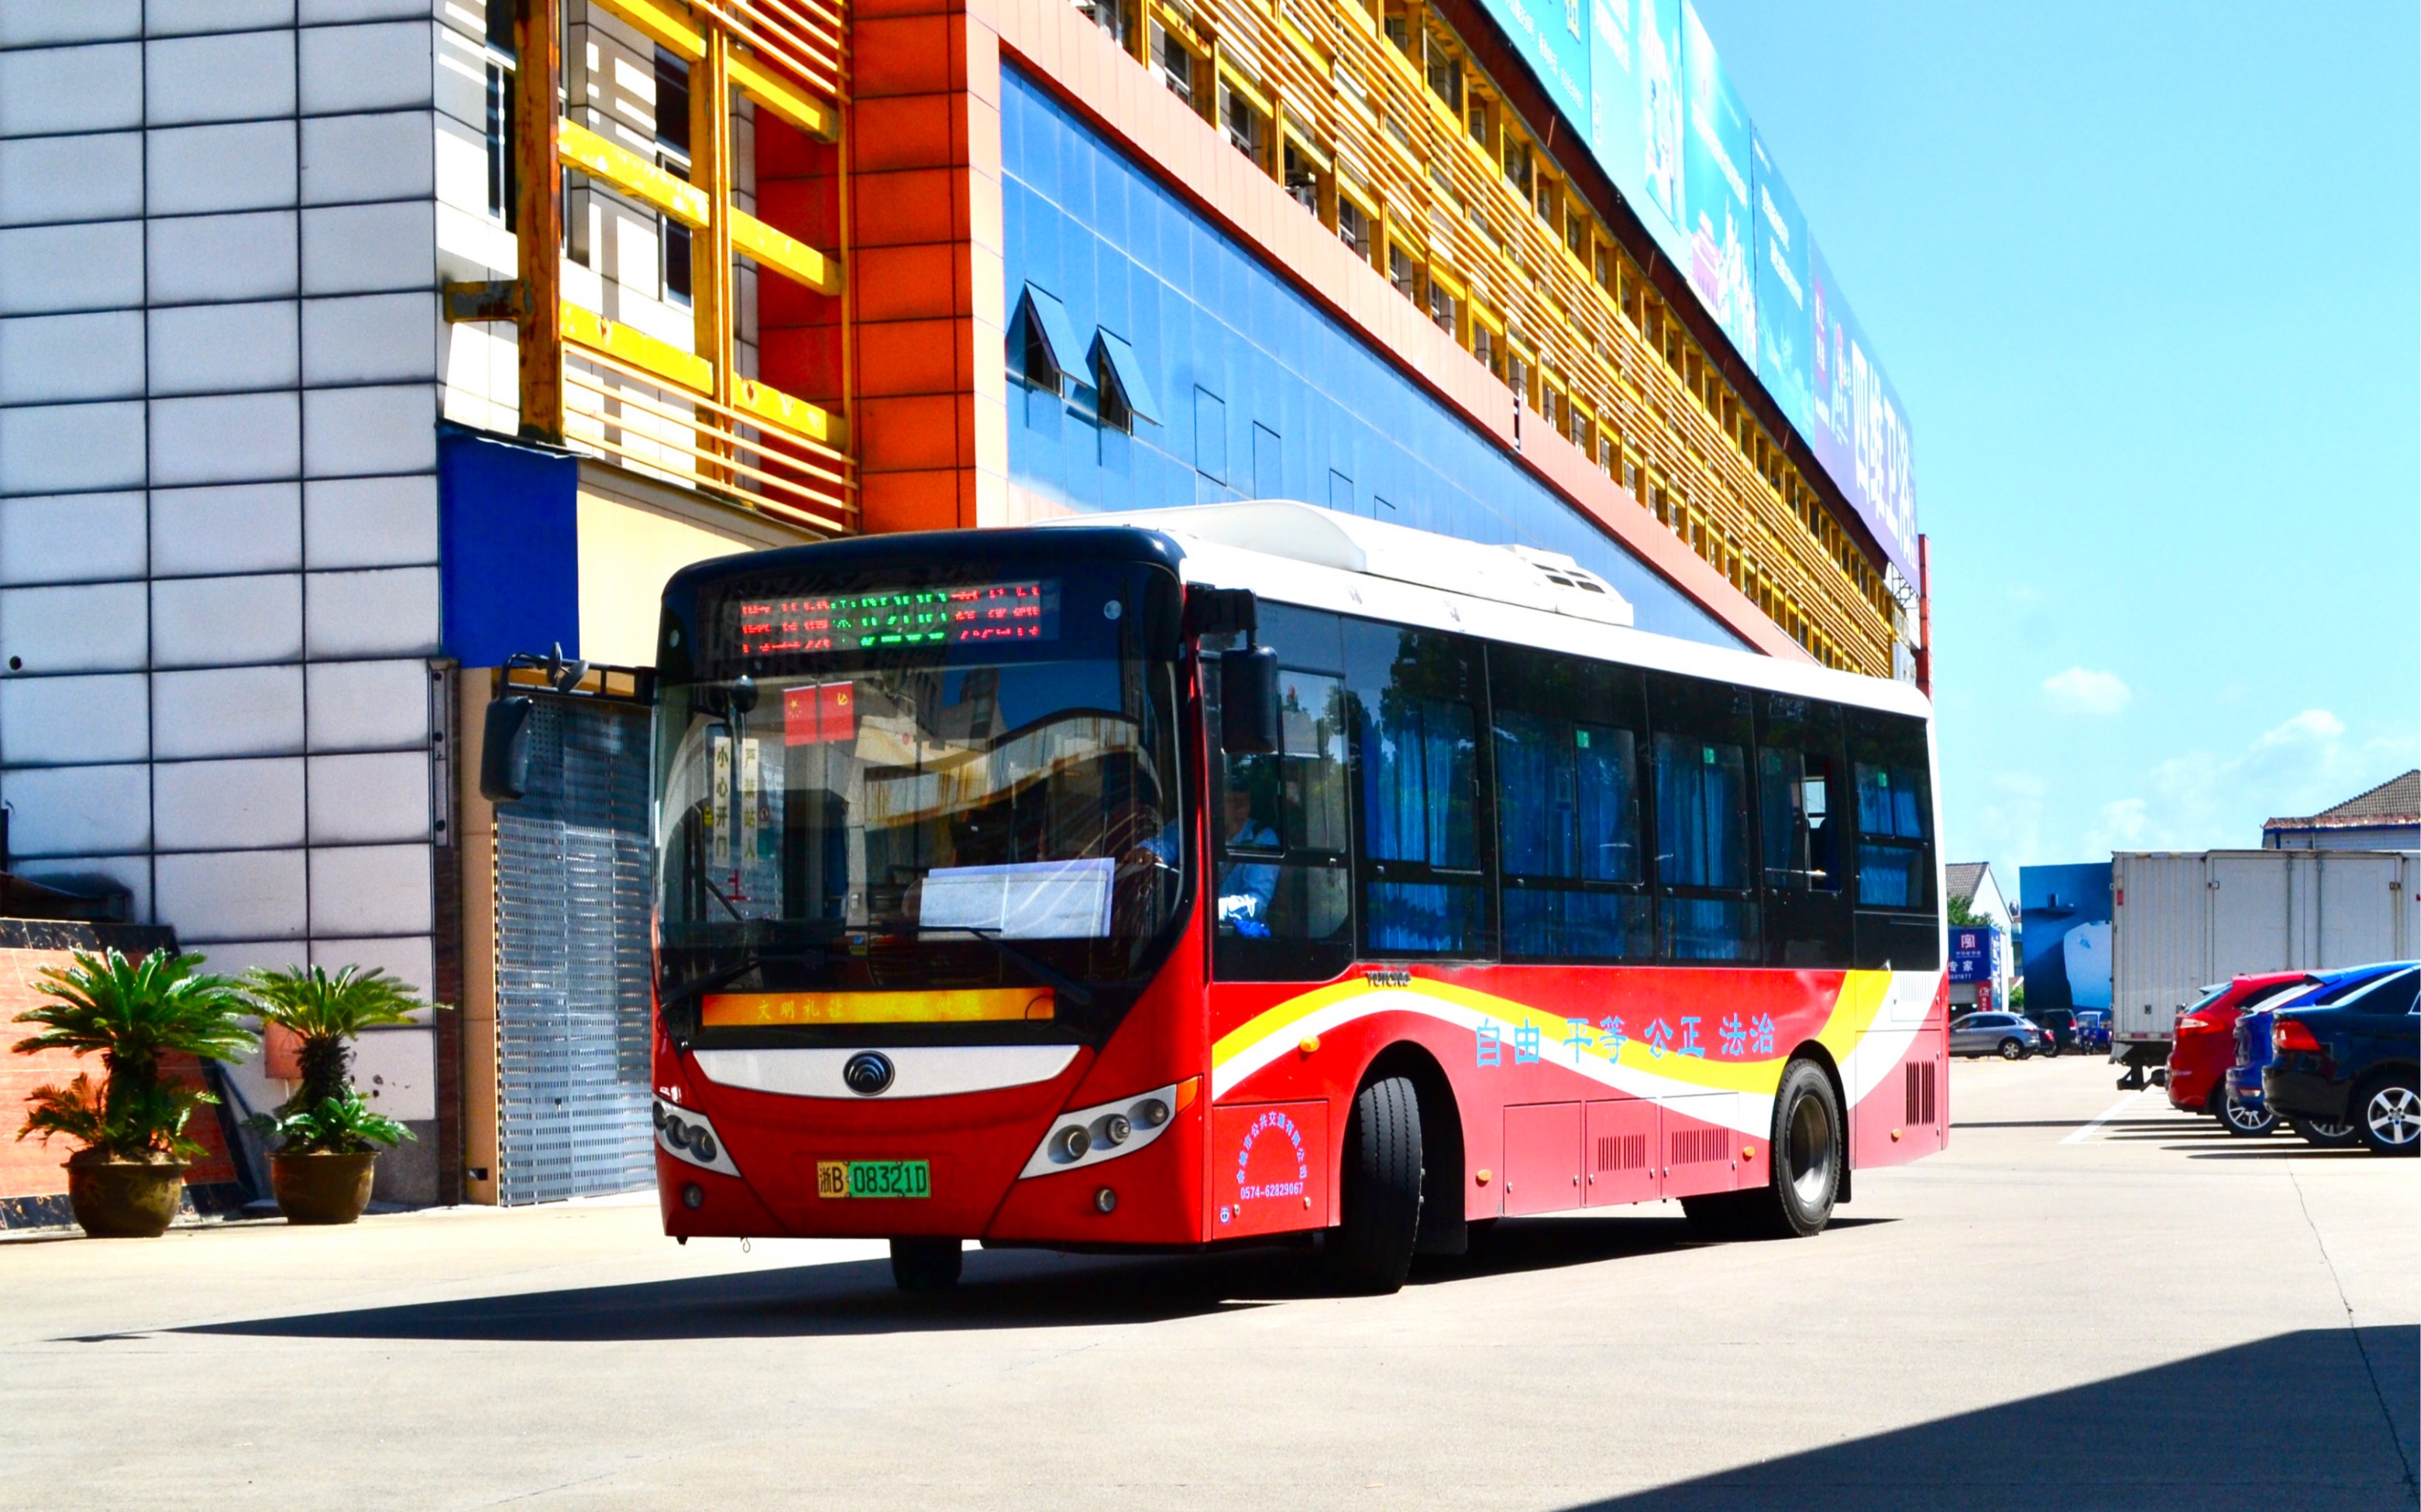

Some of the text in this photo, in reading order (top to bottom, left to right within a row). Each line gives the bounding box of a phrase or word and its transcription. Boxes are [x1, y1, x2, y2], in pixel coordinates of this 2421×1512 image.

[1851, 338, 1911, 559] 四维卫浴
[716, 745, 729, 858] 小心开门
[743, 747, 757, 859] 严禁站人
[1475, 1012, 1775, 1067] 自由 平等 公正 法治
[1240, 1182, 1304, 1200] 0574-62829067
